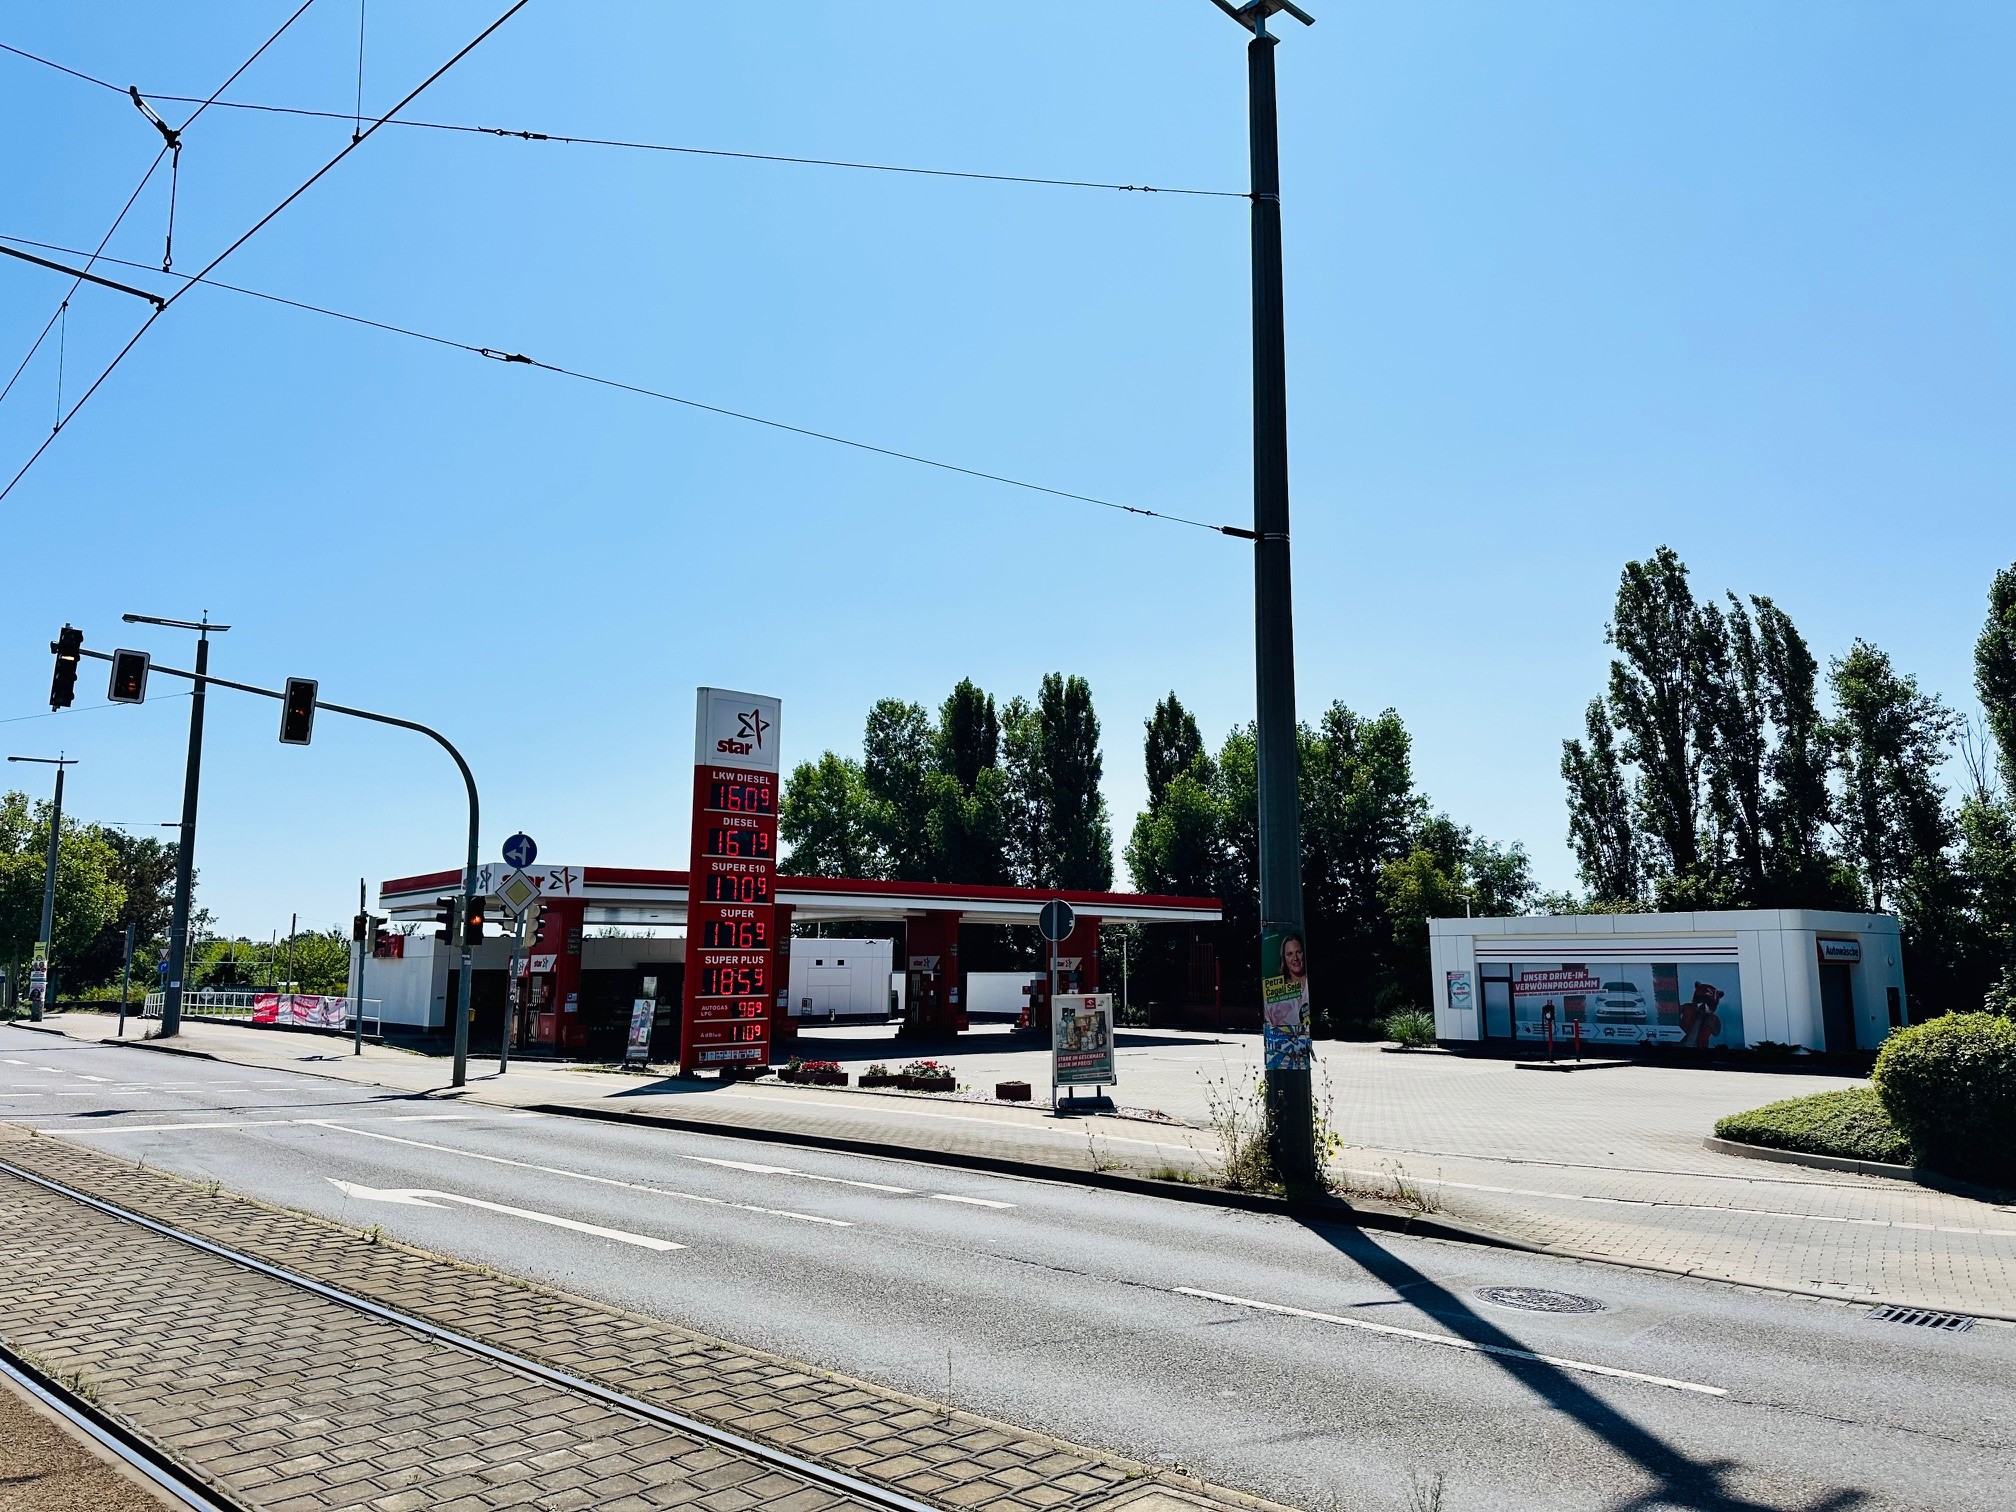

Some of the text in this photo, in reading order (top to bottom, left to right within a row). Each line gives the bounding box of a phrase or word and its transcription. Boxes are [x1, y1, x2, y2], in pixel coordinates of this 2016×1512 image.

[716, 737, 753, 756] star
[712, 771, 771, 785] LKW DIESEL
[722, 817, 759, 828] DIESEL
[711, 862, 766, 874] SUPER E10
[720, 908, 754, 918] SUPER
[1825, 945, 1859, 957] Autowäsche
[704, 955, 764, 965] SUPER PLUS
[1523, 971, 1587, 982] UNSER DRIVE-IN-
[1265, 977, 1283, 988] Petra
[1515, 979, 1598, 991] VERWÖHNPROGRAMM
